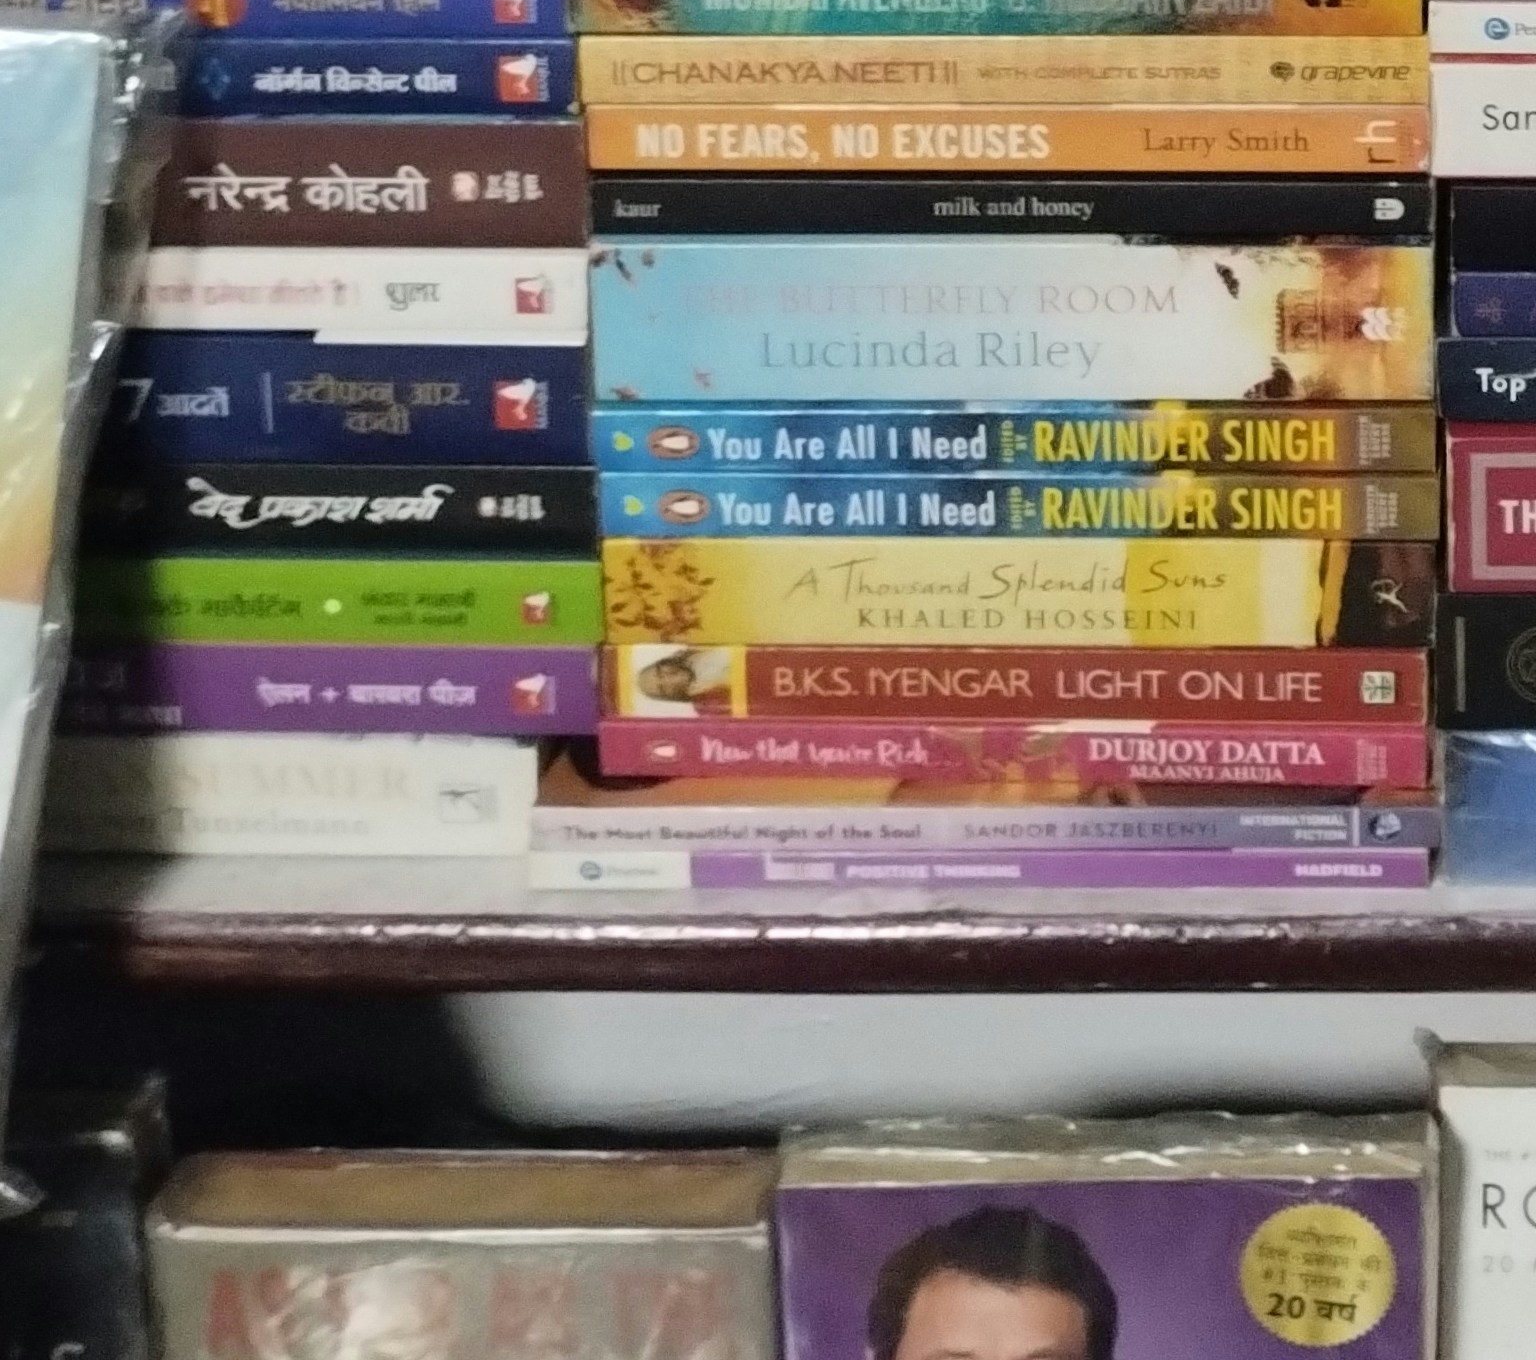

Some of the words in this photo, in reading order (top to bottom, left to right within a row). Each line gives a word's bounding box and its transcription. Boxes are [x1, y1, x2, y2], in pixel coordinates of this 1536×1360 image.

[635, 124, 689, 158] NO
[697, 124, 819, 163] FEARS,
[833, 124, 884, 158] NO
[894, 123, 1050, 159] EXCUSES
[301, 163, 430, 213] कोहली
[934, 195, 981, 219] milk
[986, 195, 1025, 218] and
[1031, 195, 1095, 223] honey
[1034, 422, 1216, 462] RAVINDER
[1226, 420, 1335, 461] SINGH
[1056, 671, 1164, 701] LIGHT
[1179, 671, 1244, 701] ON
[1254, 672, 1323, 703] LIFE
